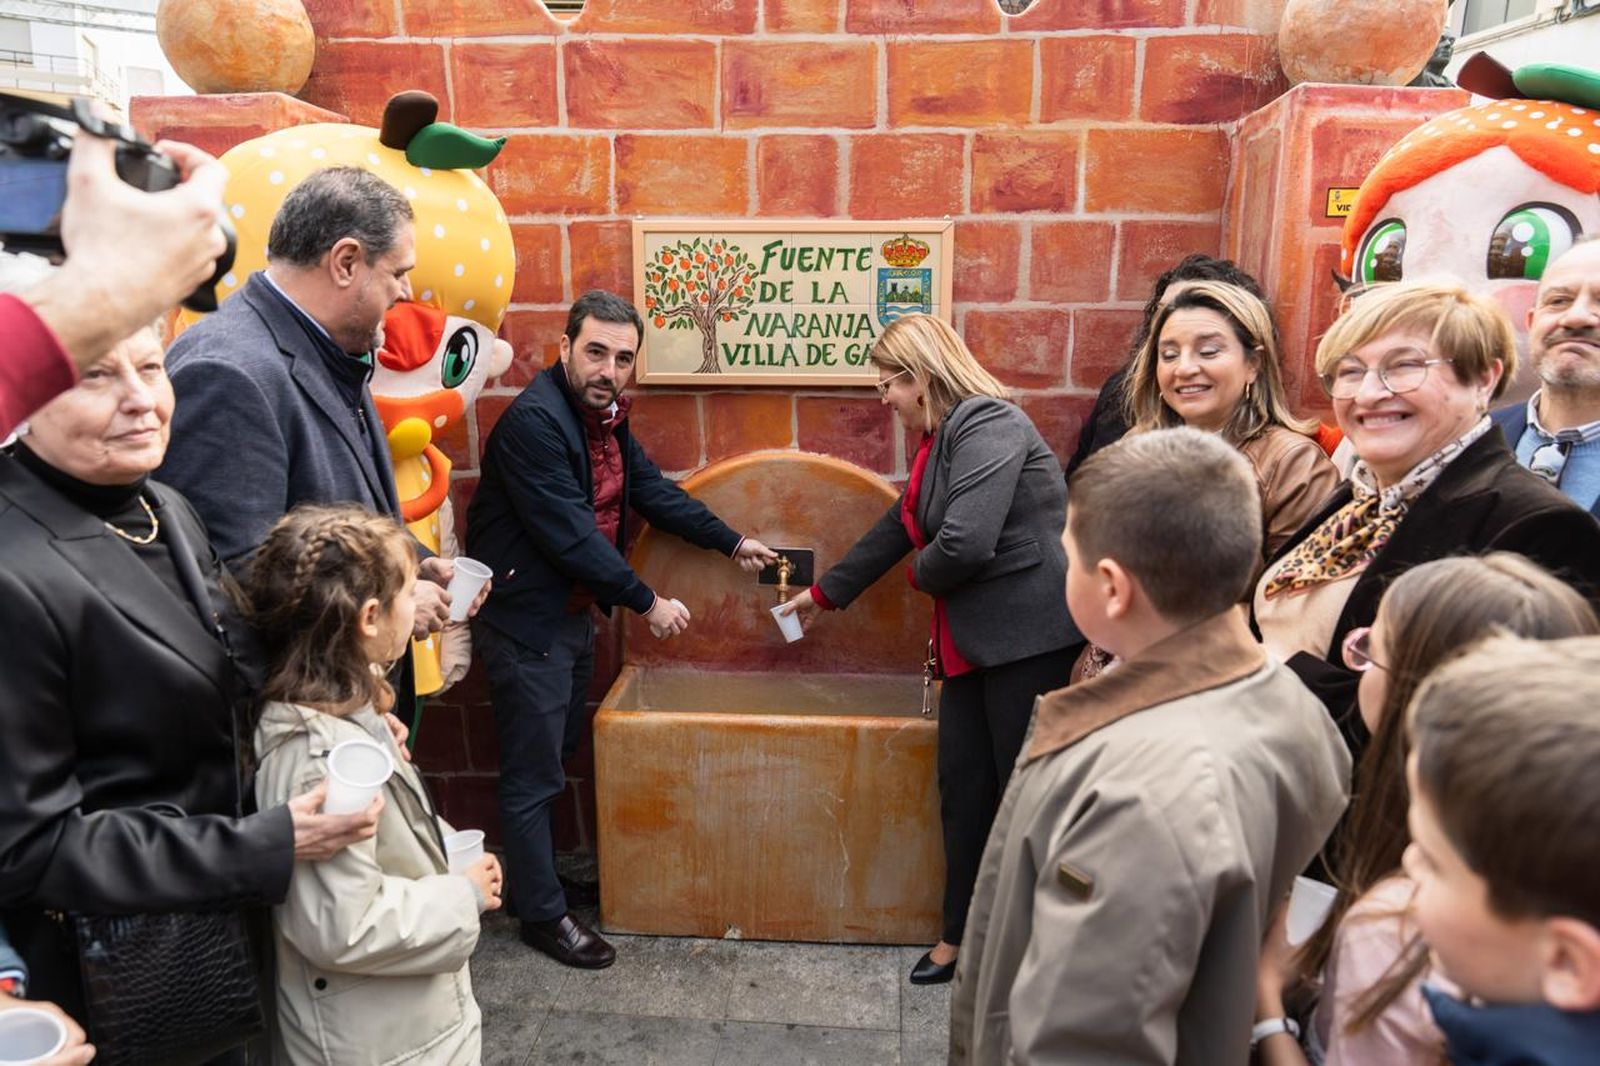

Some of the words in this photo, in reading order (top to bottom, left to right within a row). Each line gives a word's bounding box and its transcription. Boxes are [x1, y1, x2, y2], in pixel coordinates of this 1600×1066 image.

[760, 239, 874, 276] FUENTE
[758, 280, 794, 303] DE
[811, 281, 850, 304] LA
[743, 312, 876, 338] NARANJA
[721, 342, 800, 367] VILLA
[806, 343, 838, 367] DE
[844, 343, 873, 367] GA
